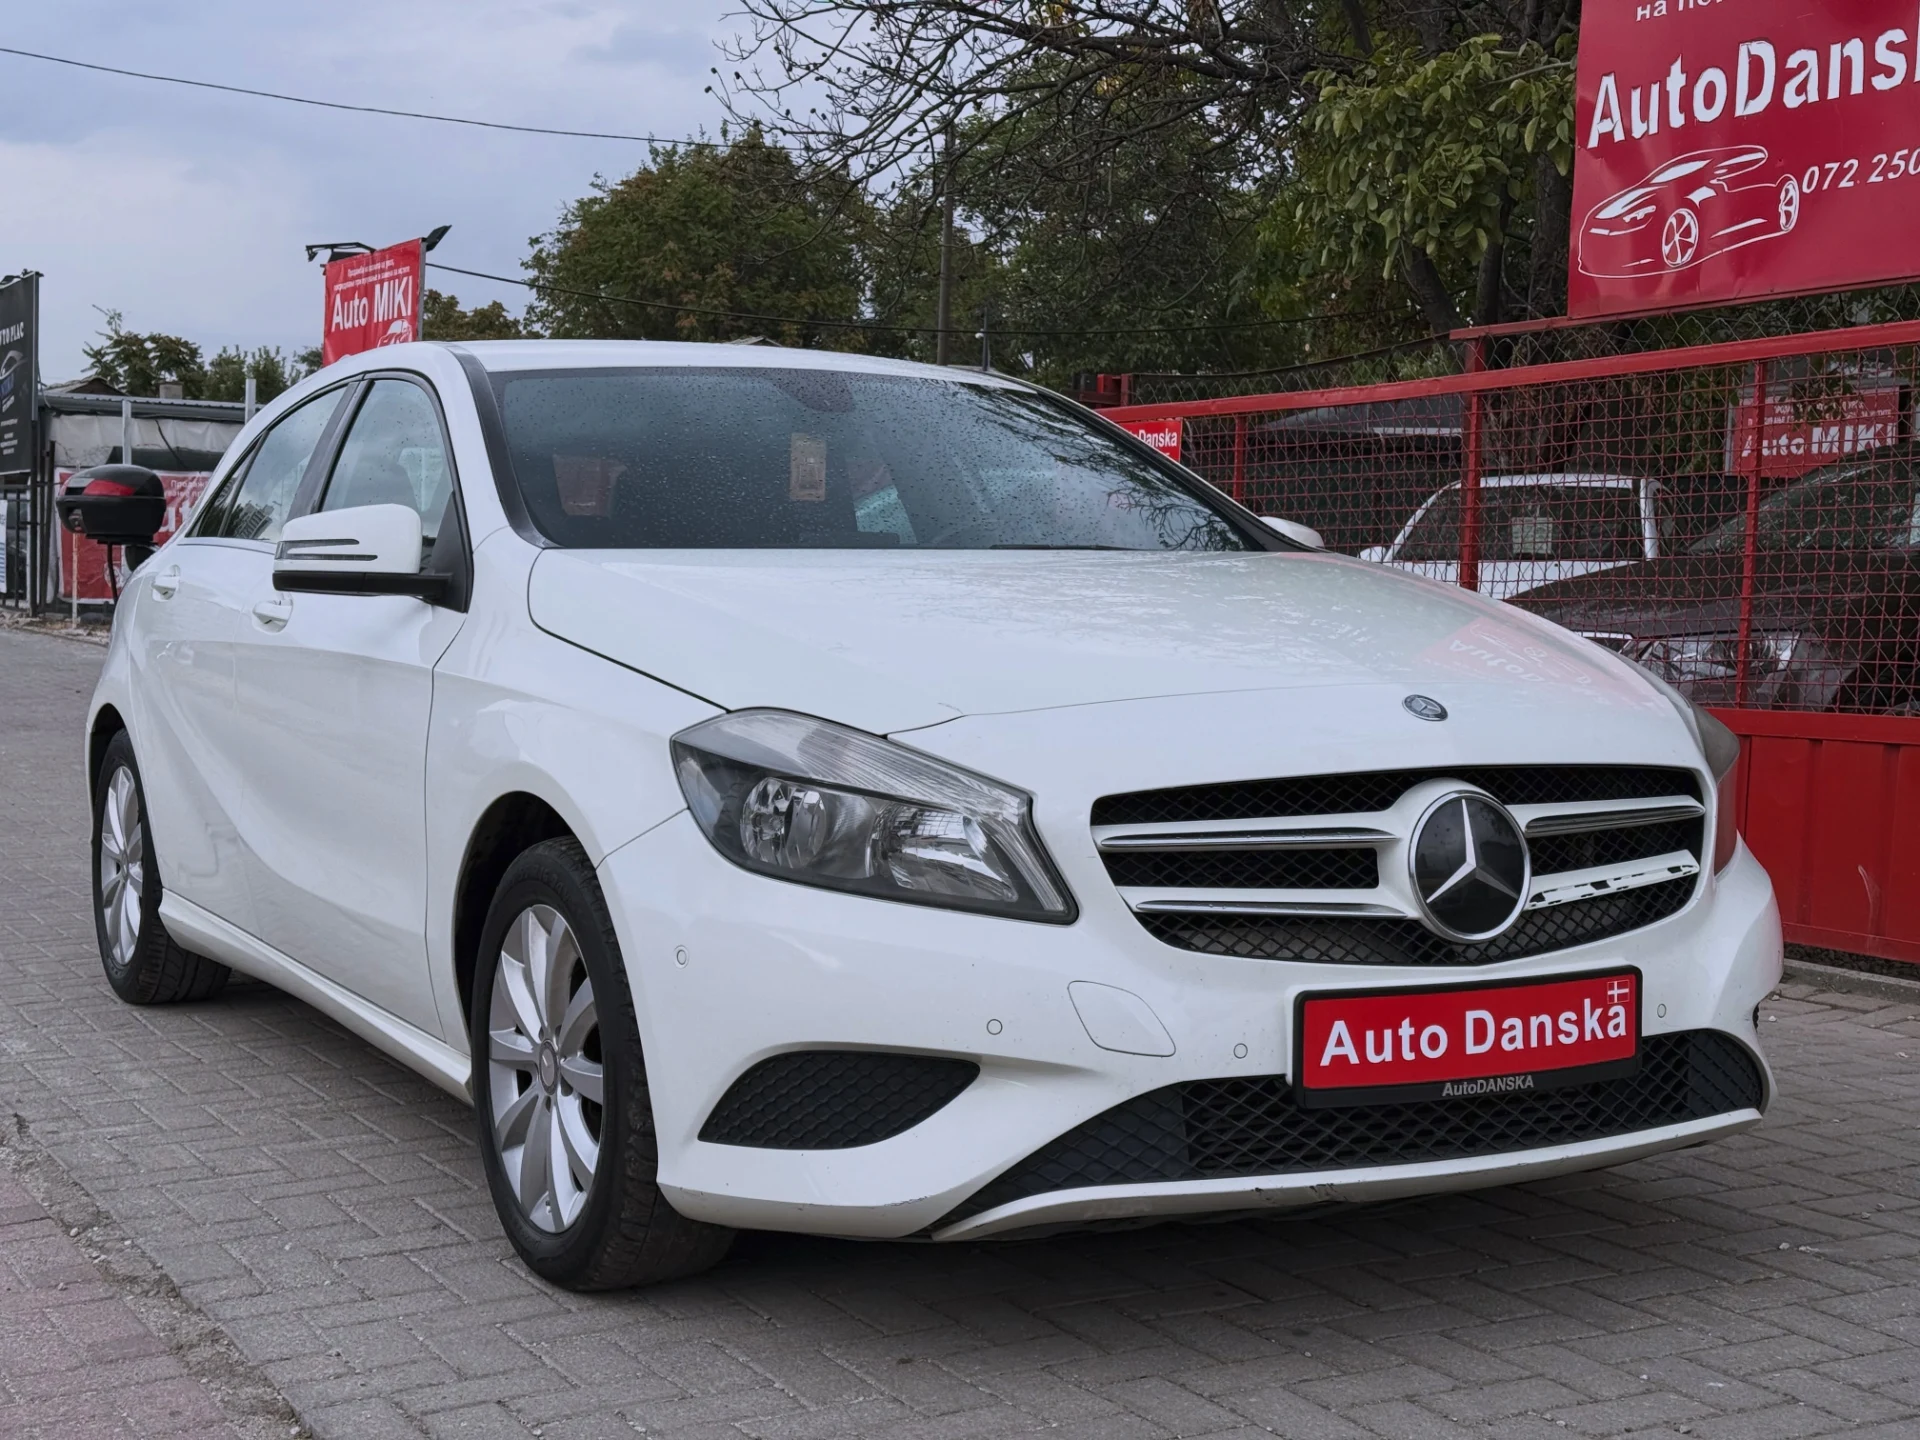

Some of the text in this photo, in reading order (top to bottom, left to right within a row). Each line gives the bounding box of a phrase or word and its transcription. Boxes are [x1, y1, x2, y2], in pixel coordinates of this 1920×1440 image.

[1802, 159, 1859, 194] 072
[331, 291, 369, 332] Auto
[373, 275, 413, 323] MIKI
[1129, 428, 1178, 447] Danska
[1811, 422, 1898, 455] MIKI
[1320, 998, 1627, 1066] Auto Danska
[1442, 1074, 1534, 1097] AutoDANSKA
